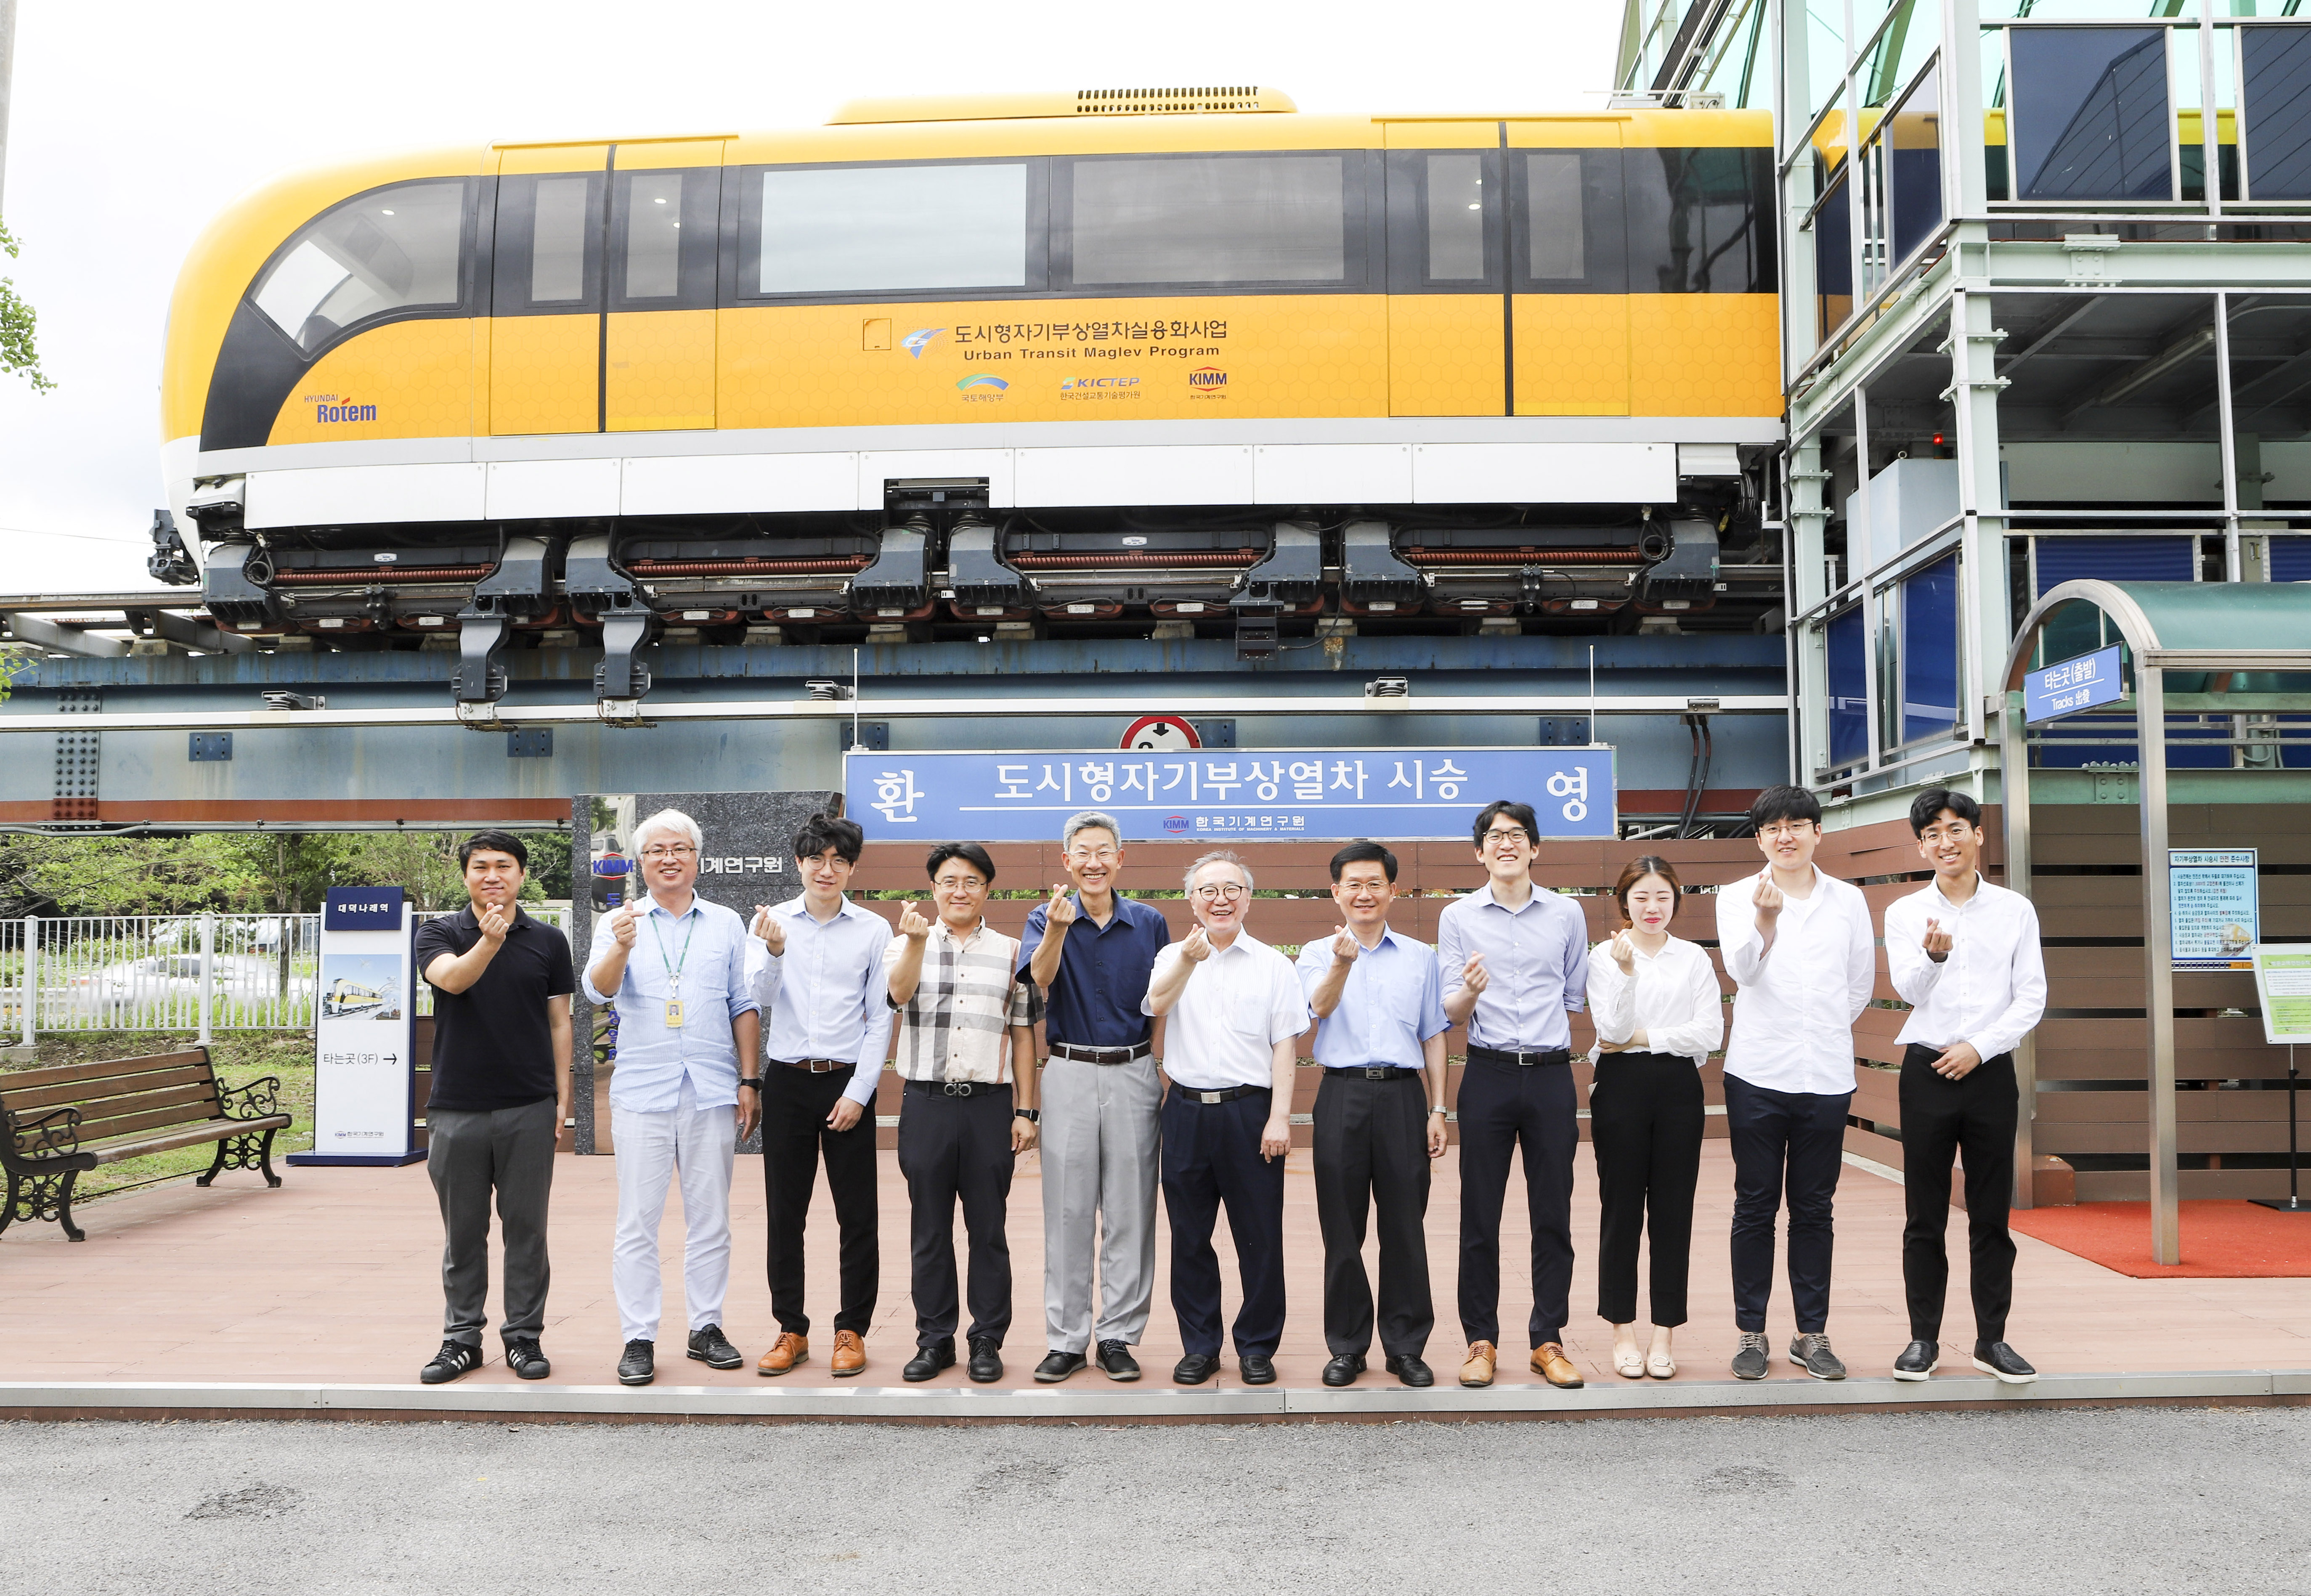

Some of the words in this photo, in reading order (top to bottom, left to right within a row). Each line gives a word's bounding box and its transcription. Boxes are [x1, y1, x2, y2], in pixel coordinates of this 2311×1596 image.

[955, 320, 1227, 343] 도시형자기부상열차실용화사업
[964, 350, 1011, 360] Urban
[1019, 348, 1076, 358] Transit
[1084, 347, 1141, 359] Maglev
[1150, 346, 1219, 358] Program
[1077, 377, 1140, 387] KICTEP
[1189, 373, 1227, 385] KIMM
[304, 394, 338, 403] HYUNDAI
[962, 394, 1003, 402] 국토해양부
[1060, 391, 1141, 400] 한국건설교통기술평가원
[317, 404, 376, 423] Rotem
[2044, 657, 2096, 690] 타는곳(출발)
[2051, 696, 2074, 711] Tracks
[2075, 689, 2091, 706] 出發
[994, 760, 1369, 802] 도시형자기부상열차
[1387, 758, 1469, 800] 시승
[870, 769, 925, 823] 환
[1546, 766, 1588, 822] 영
[1163, 820, 1189, 829] KIMM
[1196, 815, 1305, 827] 한국기계연구원
[593, 859, 633, 874] KIMM
[338, 903, 389, 913] 대덕나래역
[324, 1053, 378, 1065] 타는곳(3F)
